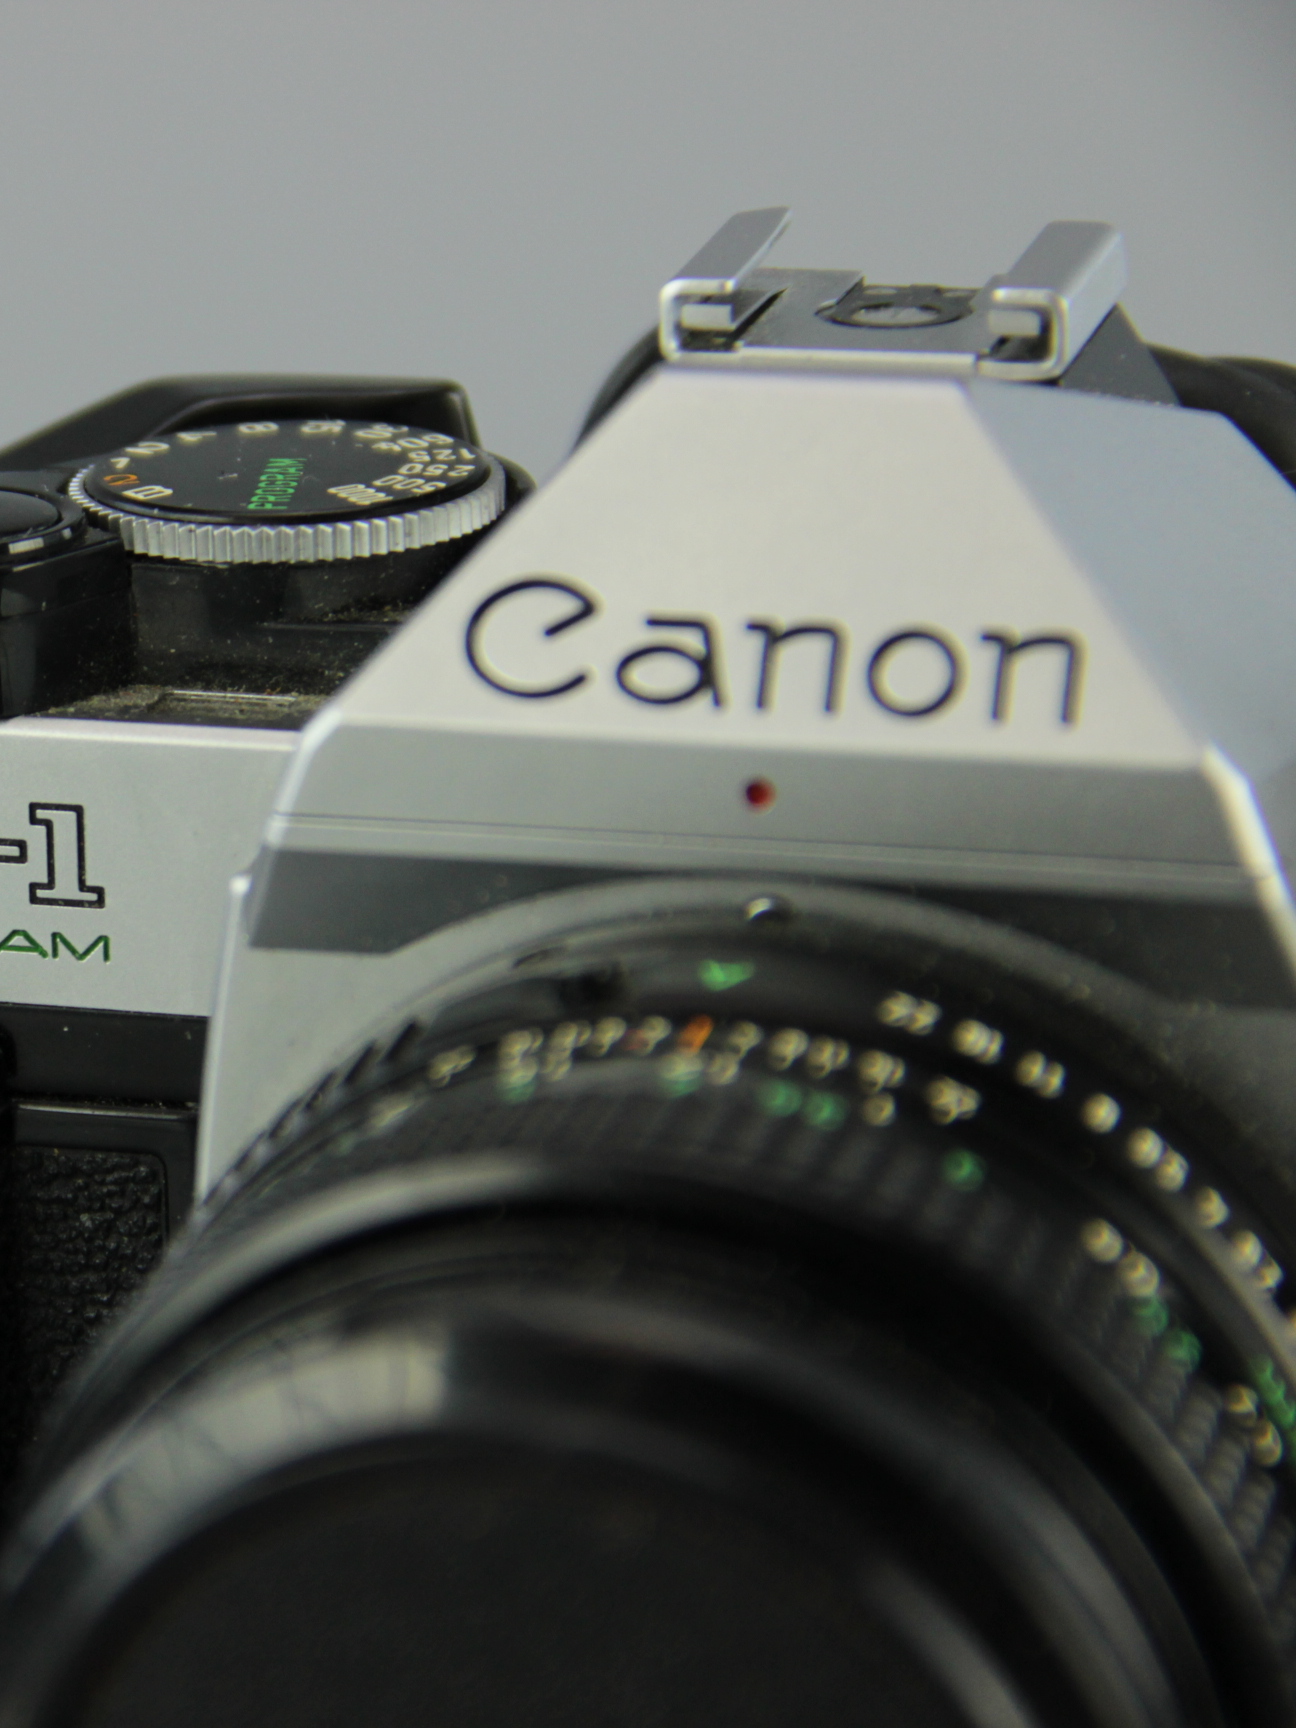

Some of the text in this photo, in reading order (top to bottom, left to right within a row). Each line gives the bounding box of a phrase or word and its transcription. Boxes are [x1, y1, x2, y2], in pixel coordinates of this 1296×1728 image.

[238, 421, 281, 434] 8
[407, 447, 477, 463] 125
[397, 462, 476, 478] 250
[122, 484, 174, 501] B
[246, 457, 308, 510] PROGRAM
[372, 474, 447, 495] 500
[326, 483, 394, 506] 1000
[465, 577, 1090, 727] Canon
